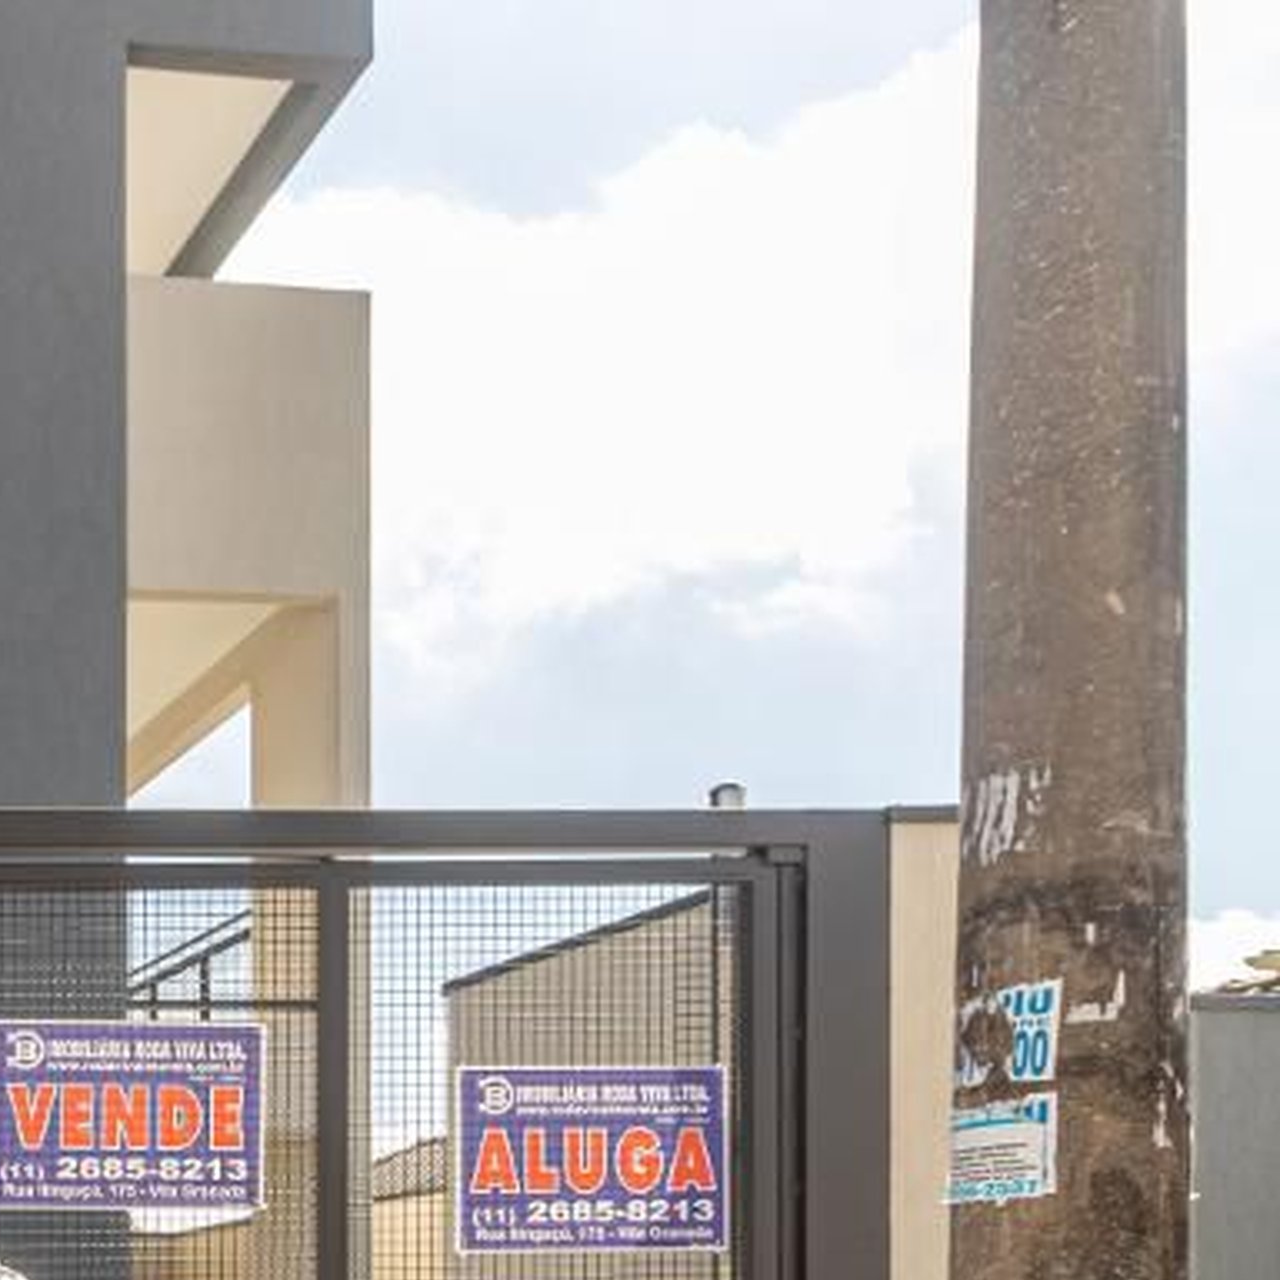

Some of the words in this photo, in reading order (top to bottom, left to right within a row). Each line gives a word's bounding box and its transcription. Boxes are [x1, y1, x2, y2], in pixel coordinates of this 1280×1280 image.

[5, 1082, 246, 1151] VENDE
[0, 1162, 45, 1181] (11)
[55, 1157, 248, 1181] 2685-8213
[469, 1125, 718, 1195] ALUGA
[472, 1206, 517, 1226] (11)
[526, 1200, 715, 1222] 2685-8213
